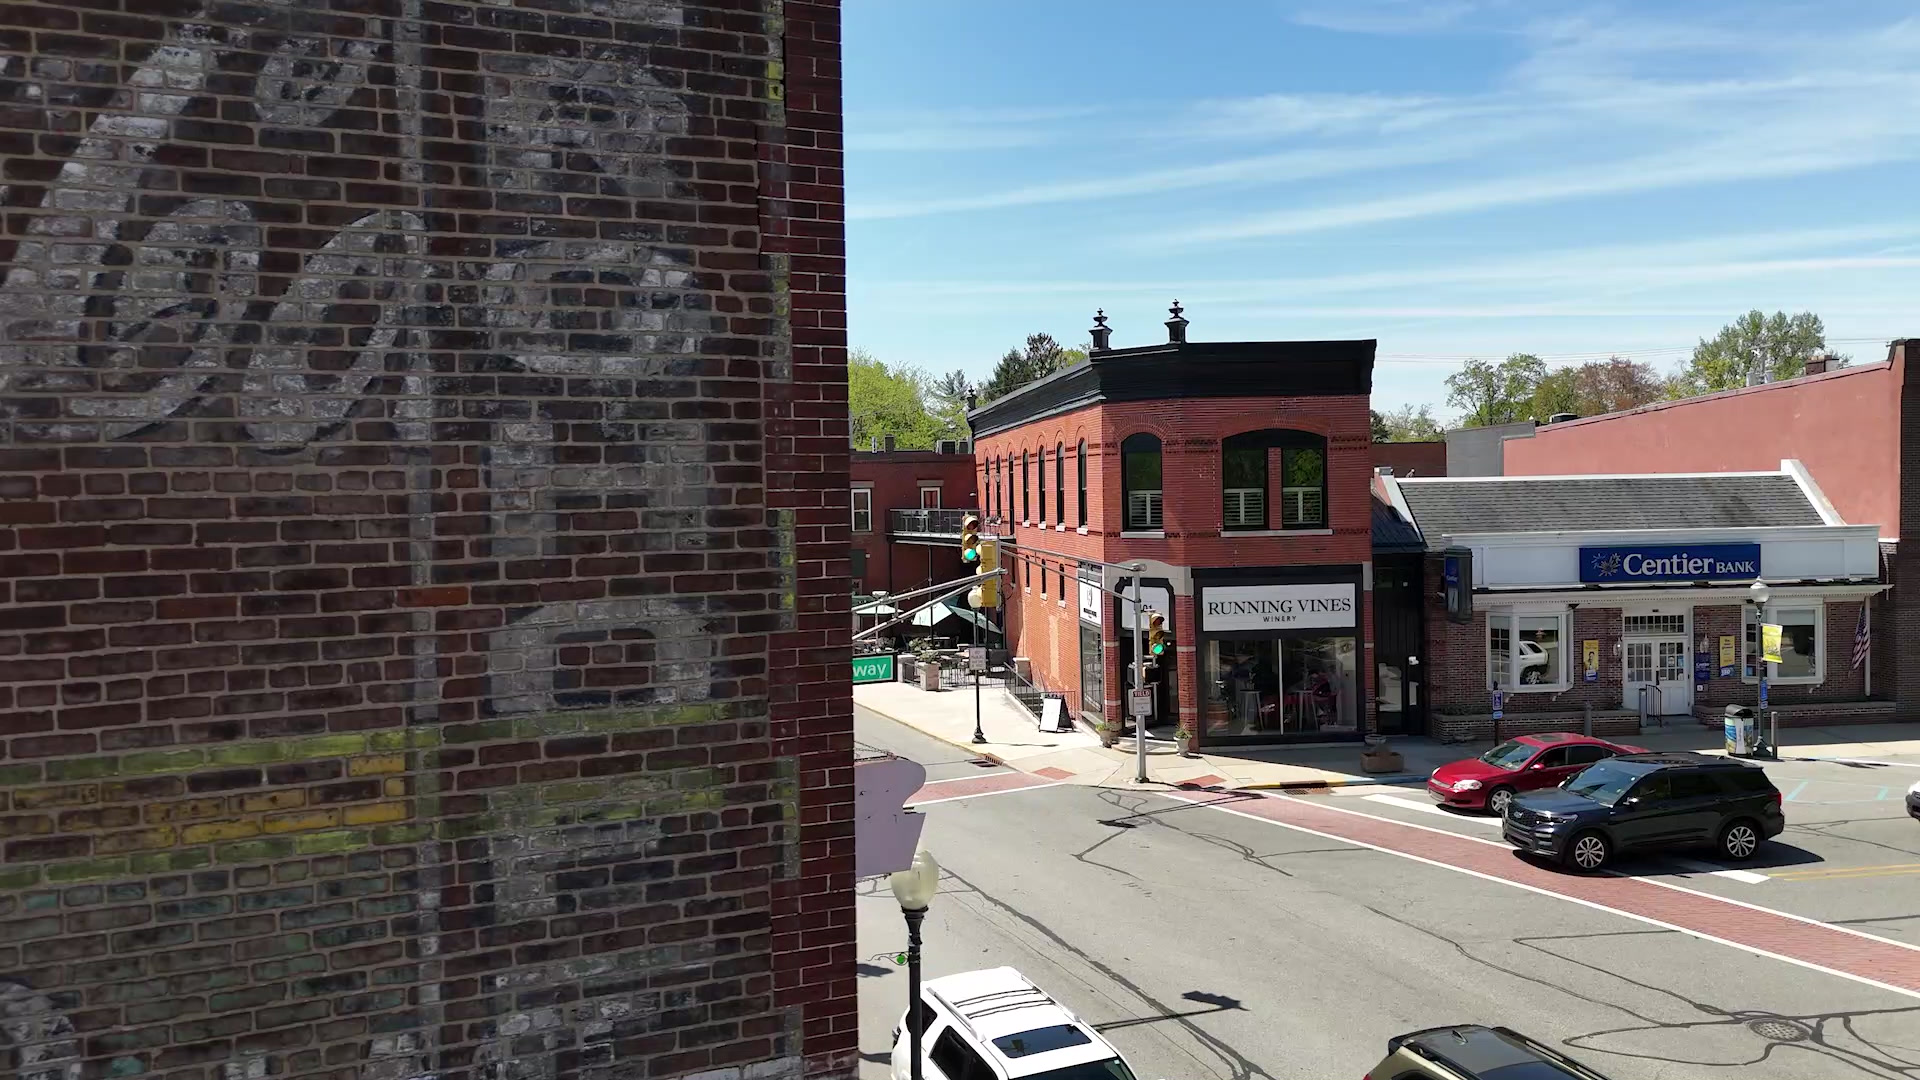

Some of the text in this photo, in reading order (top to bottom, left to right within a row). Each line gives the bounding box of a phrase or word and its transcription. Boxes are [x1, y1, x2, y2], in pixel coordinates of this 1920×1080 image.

[1623, 553, 1755, 576] Centier BANK
[1208, 598, 1351, 615] RUNNING VINES
